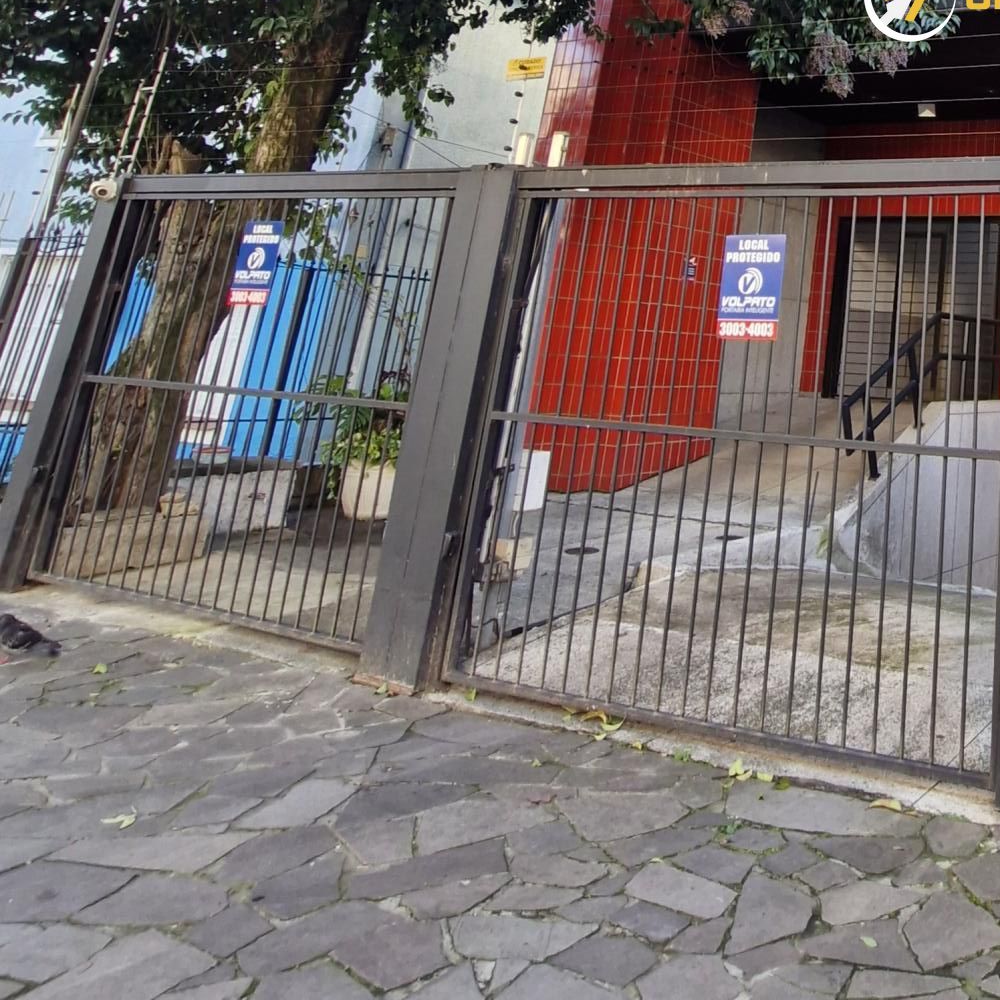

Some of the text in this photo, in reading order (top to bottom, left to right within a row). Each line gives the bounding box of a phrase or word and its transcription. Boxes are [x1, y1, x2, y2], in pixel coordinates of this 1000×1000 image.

[738, 239, 769, 250] LOCAL
[726, 251, 781, 263] PROTEGIDO
[721, 296, 776, 308] VOLPATO
[719, 322, 774, 337] 3003-4003
